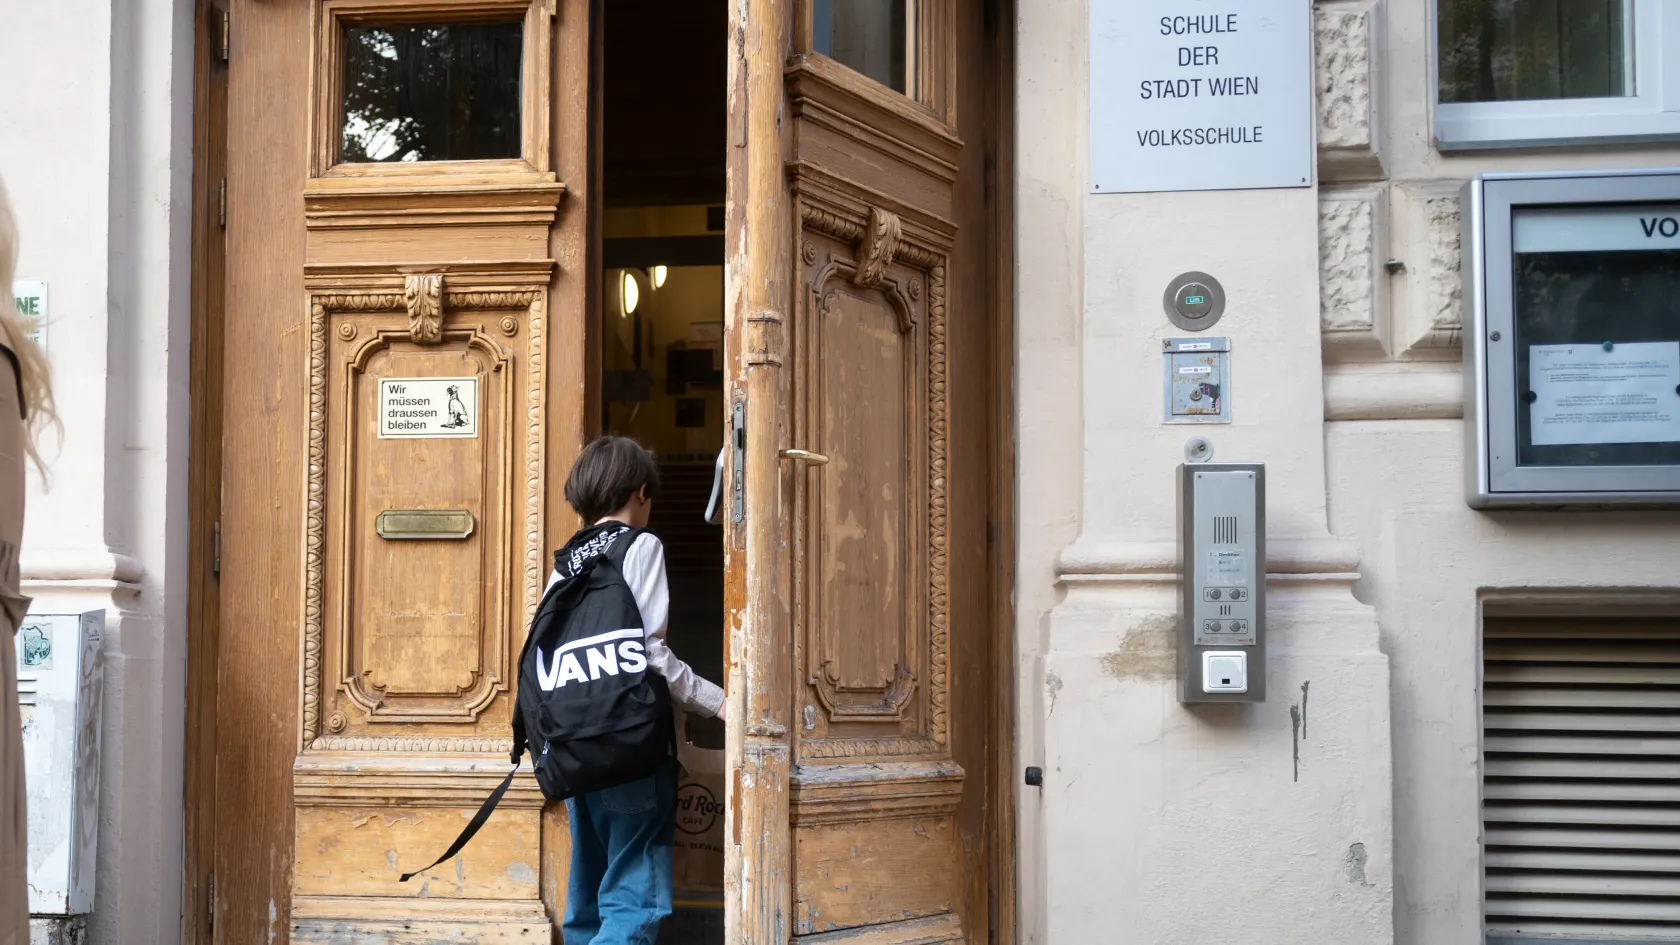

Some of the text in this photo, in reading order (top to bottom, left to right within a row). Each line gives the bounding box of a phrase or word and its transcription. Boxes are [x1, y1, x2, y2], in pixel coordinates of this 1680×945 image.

[1160, 14, 1237, 36] SCHULE
[1178, 46, 1219, 66] DER
[1140, 76, 1259, 100] STADT WIEN
[1136, 126, 1263, 147] VOLKSSCHULE
[388, 384, 406, 394] Wir
[388, 396, 430, 406] müssen
[387, 408, 437, 418] draussen
[387, 420, 427, 430] bleiben
[536, 628, 648, 691] VANS
